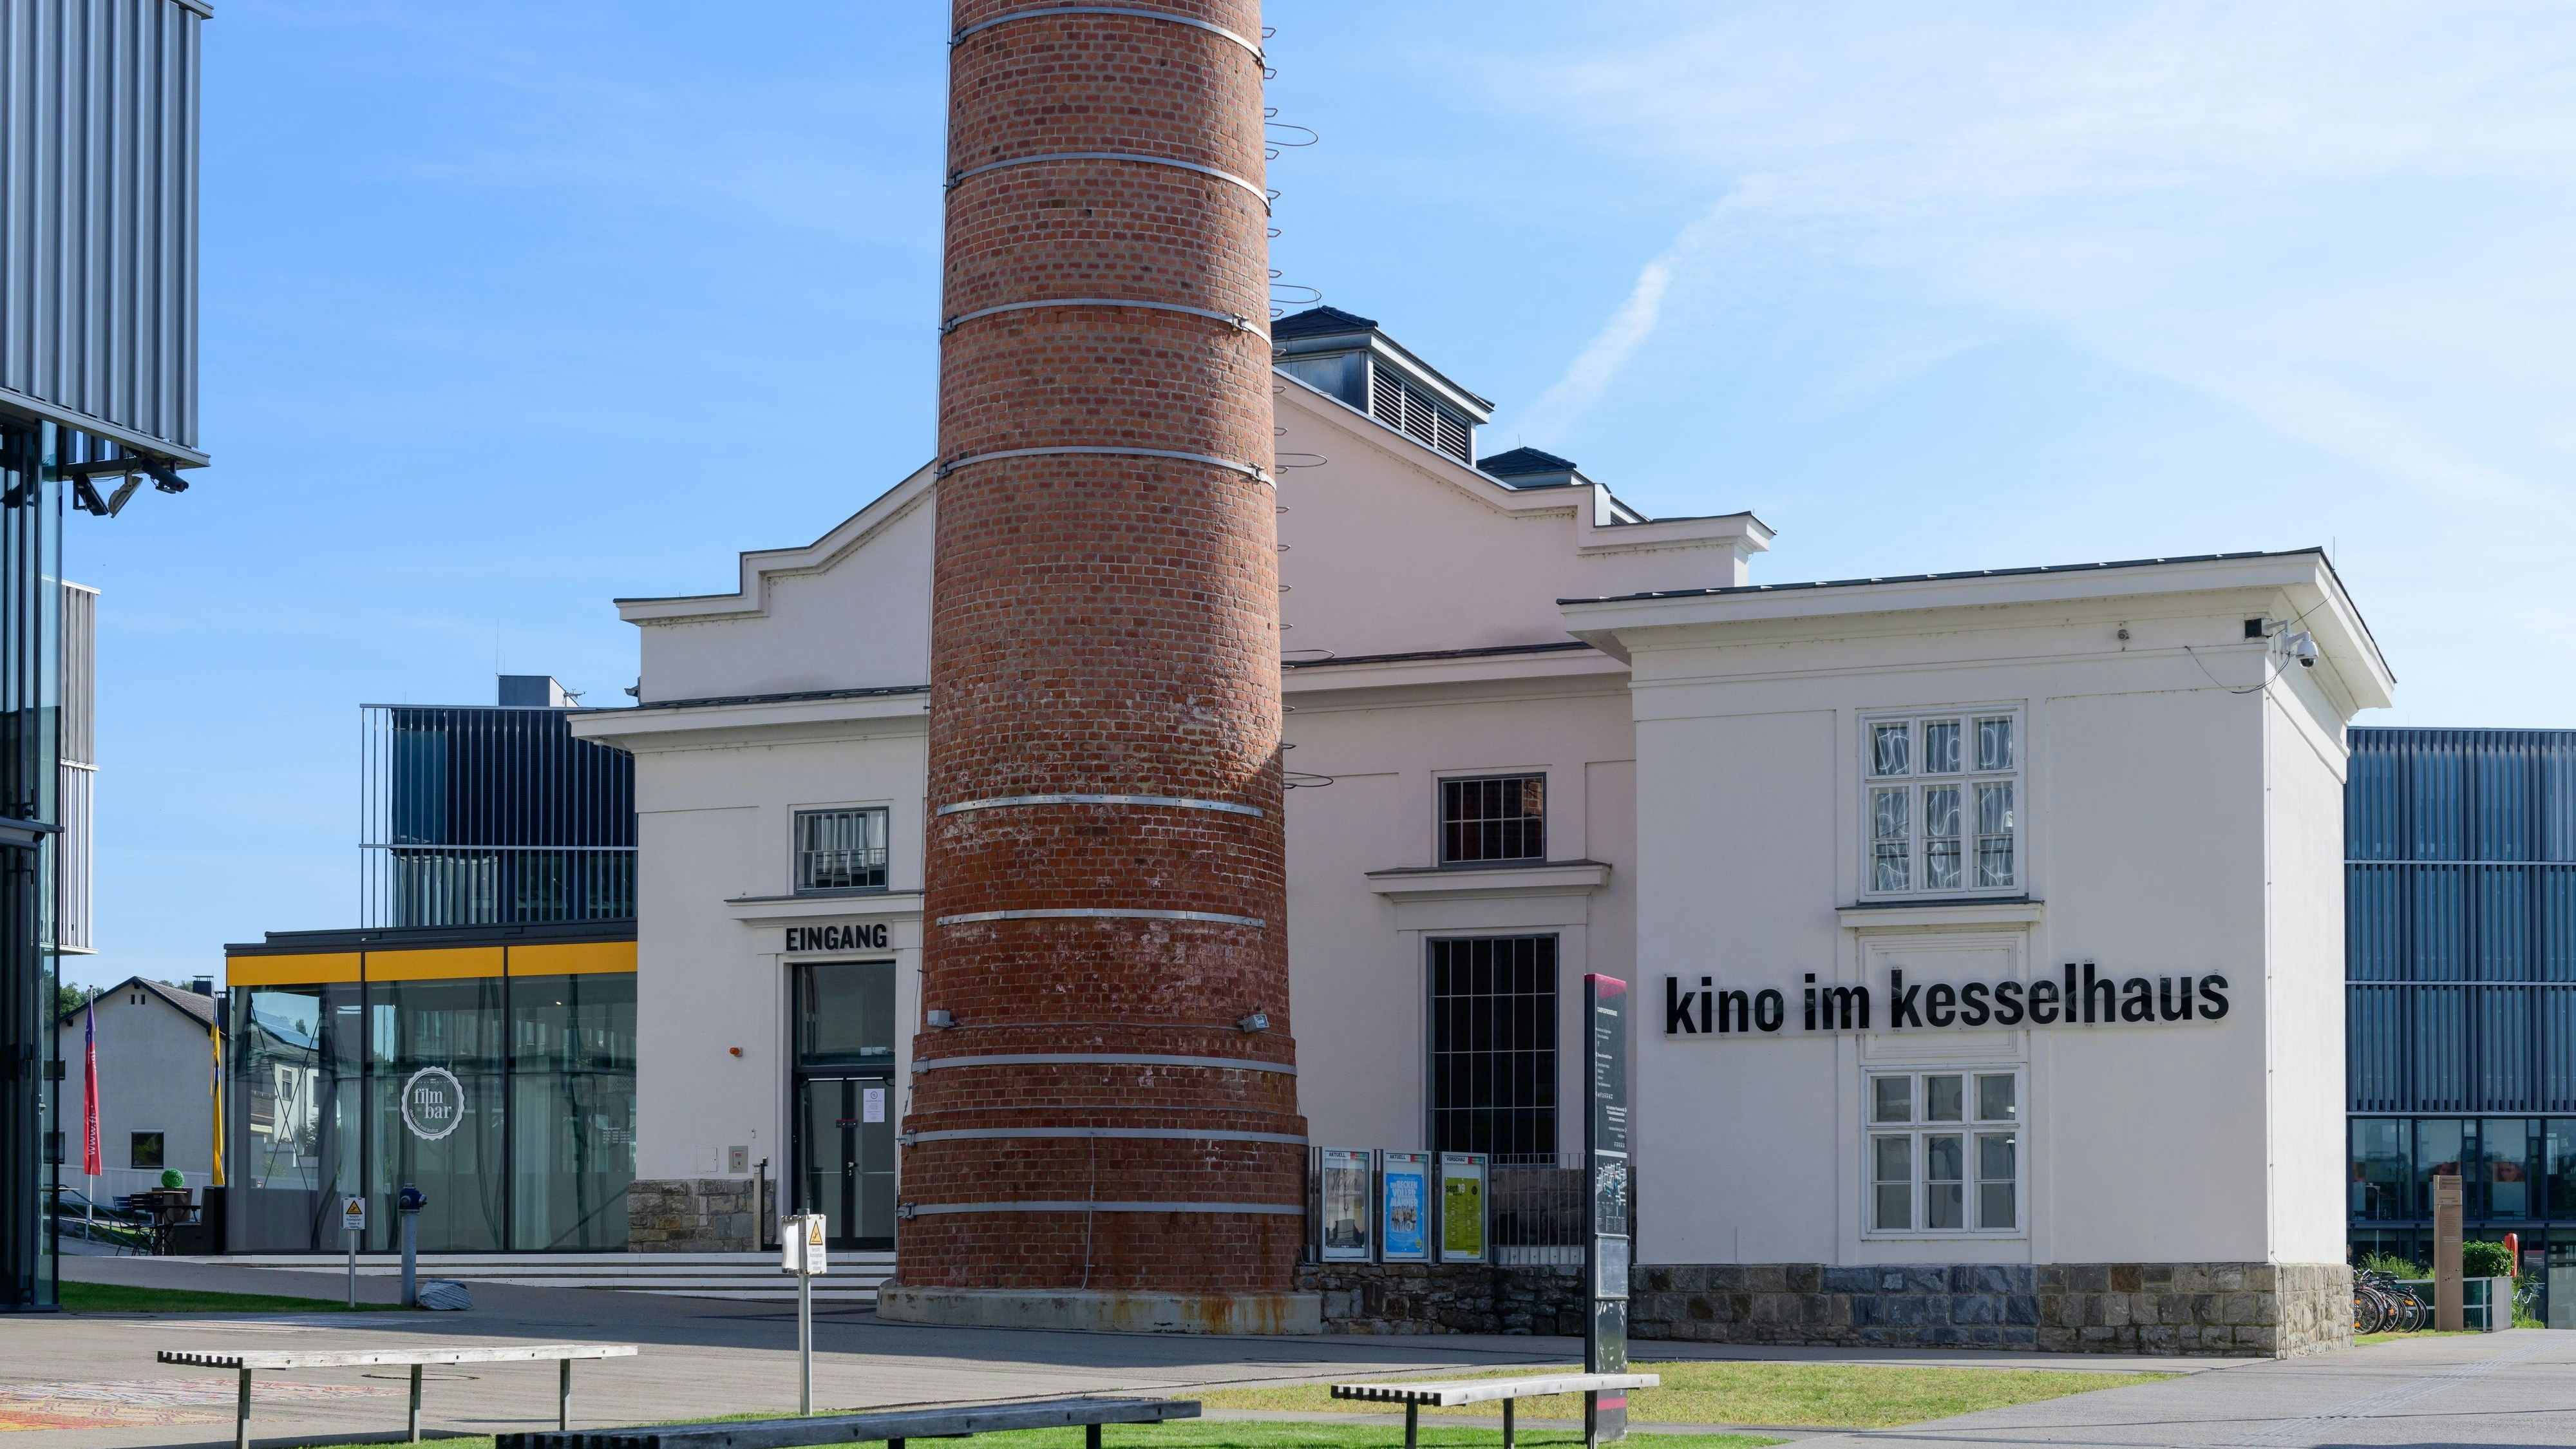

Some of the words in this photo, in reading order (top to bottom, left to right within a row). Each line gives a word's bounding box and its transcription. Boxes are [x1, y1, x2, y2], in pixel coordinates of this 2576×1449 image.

[786, 924, 887, 951] EINGANG
[1665, 976, 1784, 1034] kino
[1804, 973, 1870, 1030] im
[1891, 963, 2230, 1028] kesselhaus
[413, 1088, 444, 1104] film
[424, 1106, 452, 1119] bar
[1396, 1180, 1417, 1189] BECKEN
[1392, 1188, 1416, 1198] VOLLER
